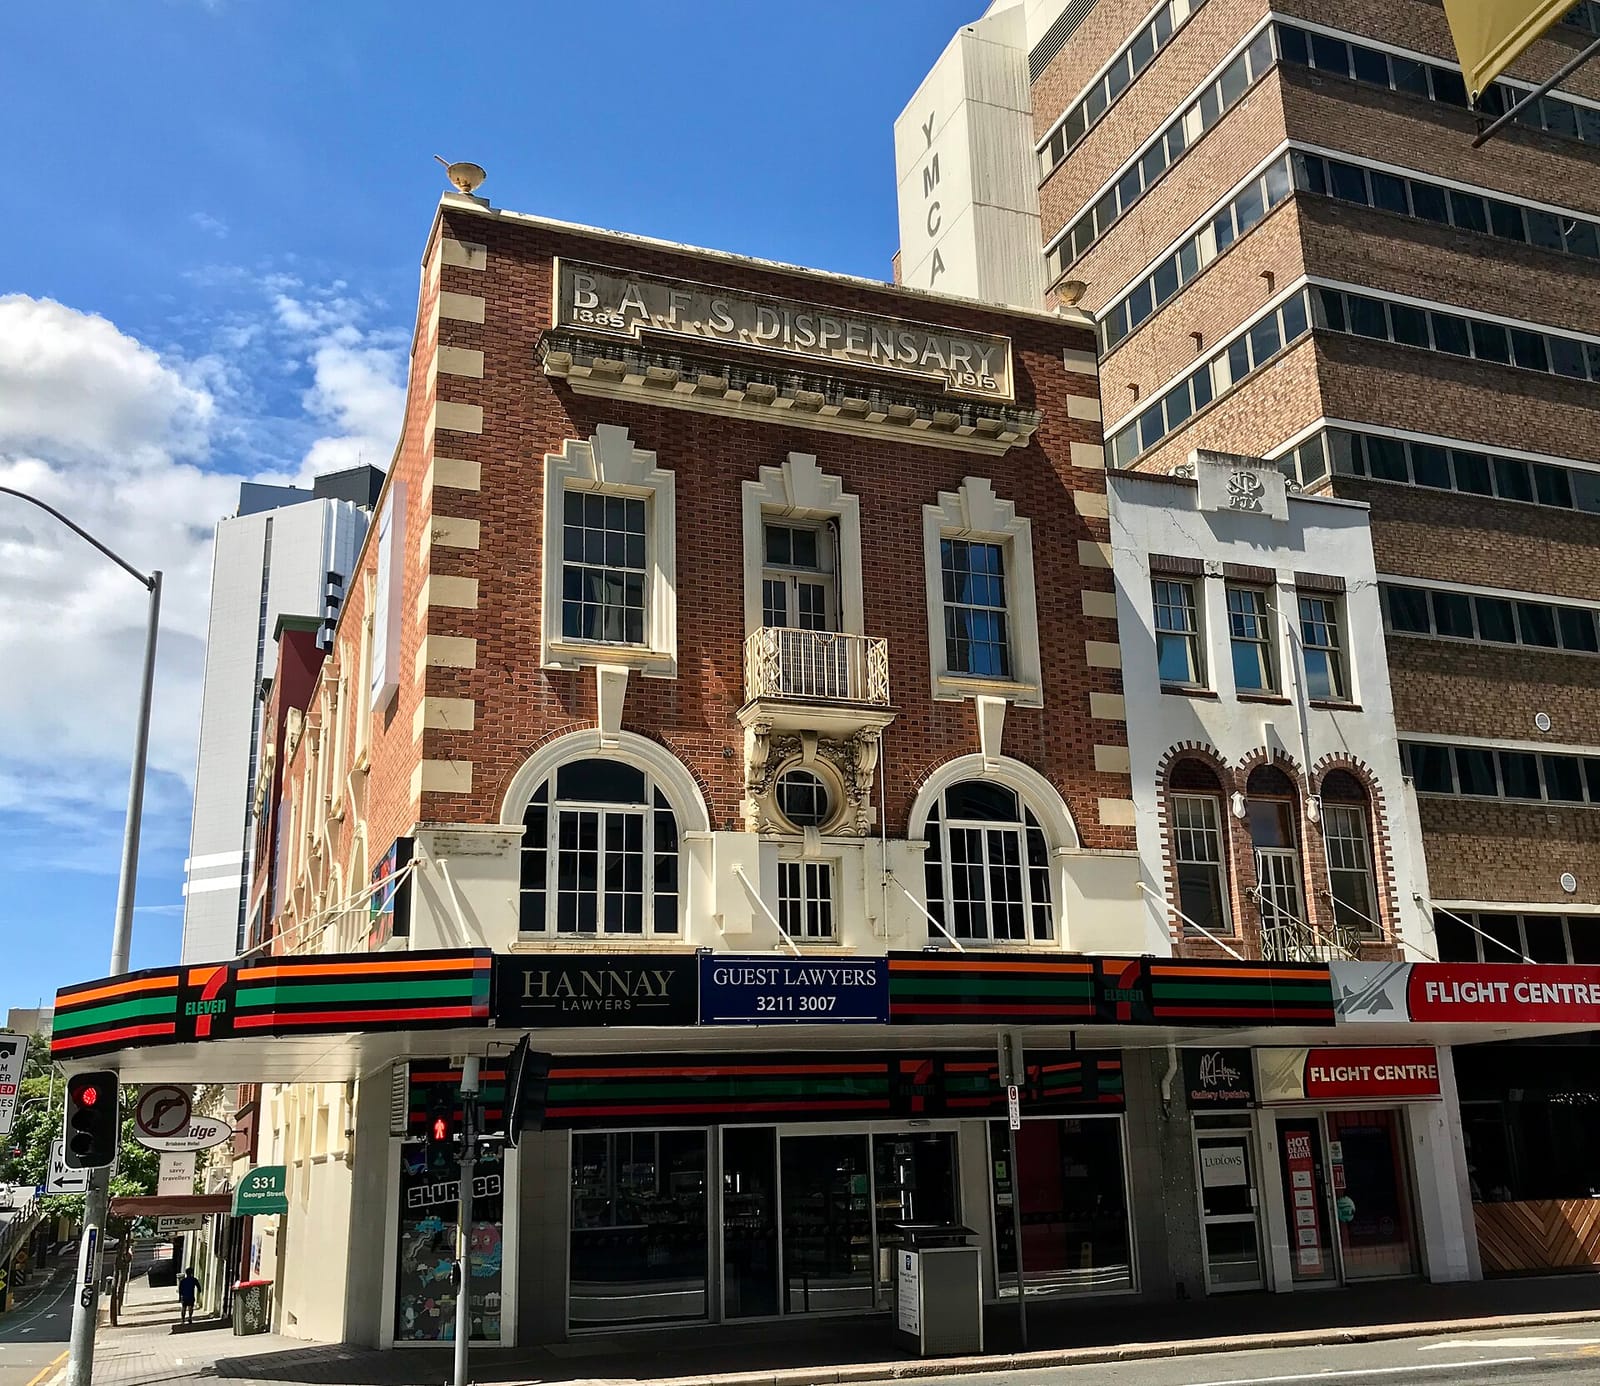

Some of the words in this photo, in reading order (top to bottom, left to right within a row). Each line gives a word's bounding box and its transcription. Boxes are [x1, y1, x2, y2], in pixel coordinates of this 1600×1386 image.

[573, 308, 625, 328] 1885
[755, 305, 996, 376] DISPENSARY
[958, 372, 997, 393] 1915
[521, 970, 676, 998] HANNAY
[713, 967, 779, 986] GUEST
[784, 969, 877, 986] LAWYERS
[1425, 981, 1508, 1003] FLIGHT
[1513, 981, 1600, 1004] CENTRE
[562, 1000, 632, 1011] LAWYERS
[756, 996, 794, 1012] 3211
[799, 996, 836, 1012] 3007
[1311, 1066, 1371, 1082] FLIGHT
[1374, 1064, 1437, 1081] CENTRE
[1287, 1137, 1309, 1147] HOT
[252, 1177, 276, 1189] 331
